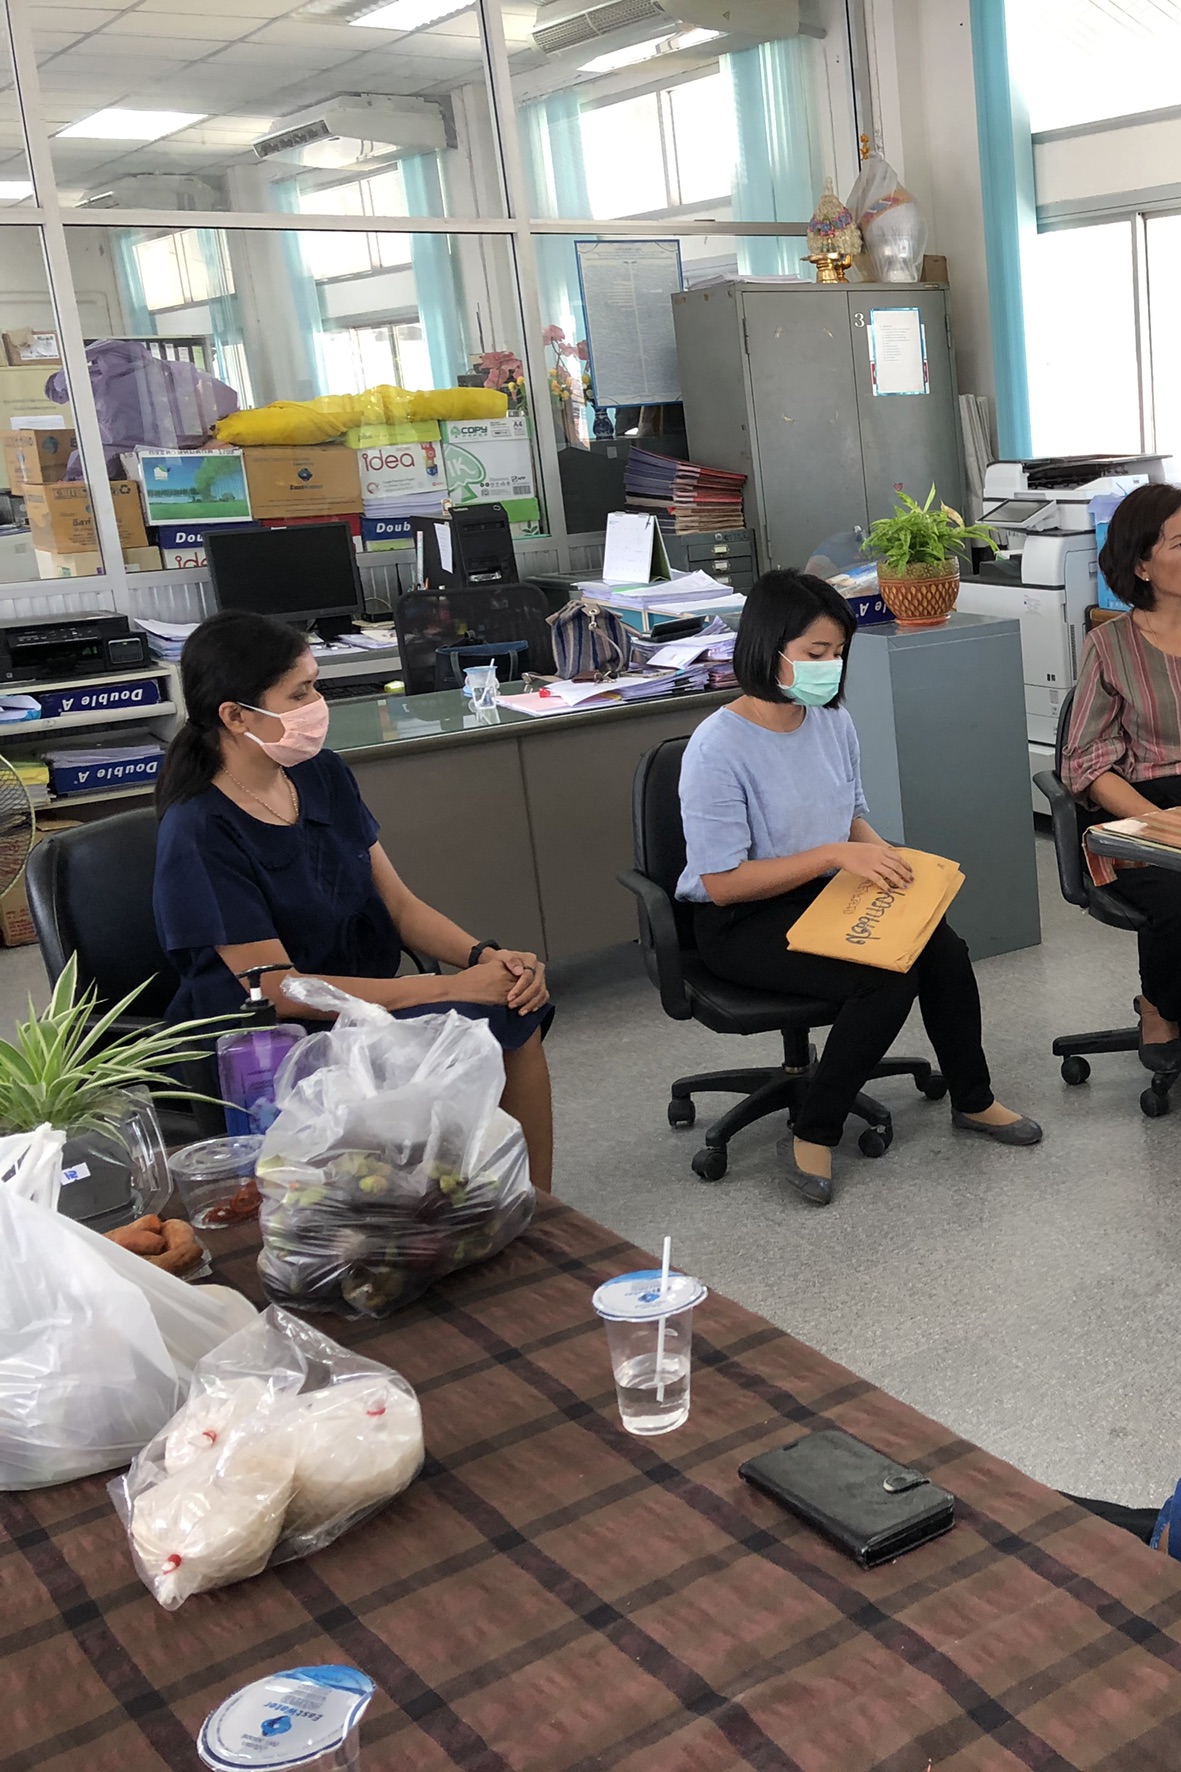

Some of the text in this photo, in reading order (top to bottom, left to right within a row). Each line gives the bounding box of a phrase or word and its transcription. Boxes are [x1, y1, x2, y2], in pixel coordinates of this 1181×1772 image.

[854, 313, 865, 327] 3
[461, 426, 488, 435] COPY
[361, 450, 415, 472] idea
[376, 521, 411, 533] Doub
[175, 532, 204, 543] Dou
[61, 688, 144, 711] Double A
[77, 761, 158, 783] Double A
[263, 1701, 324, 1722] EastWater
